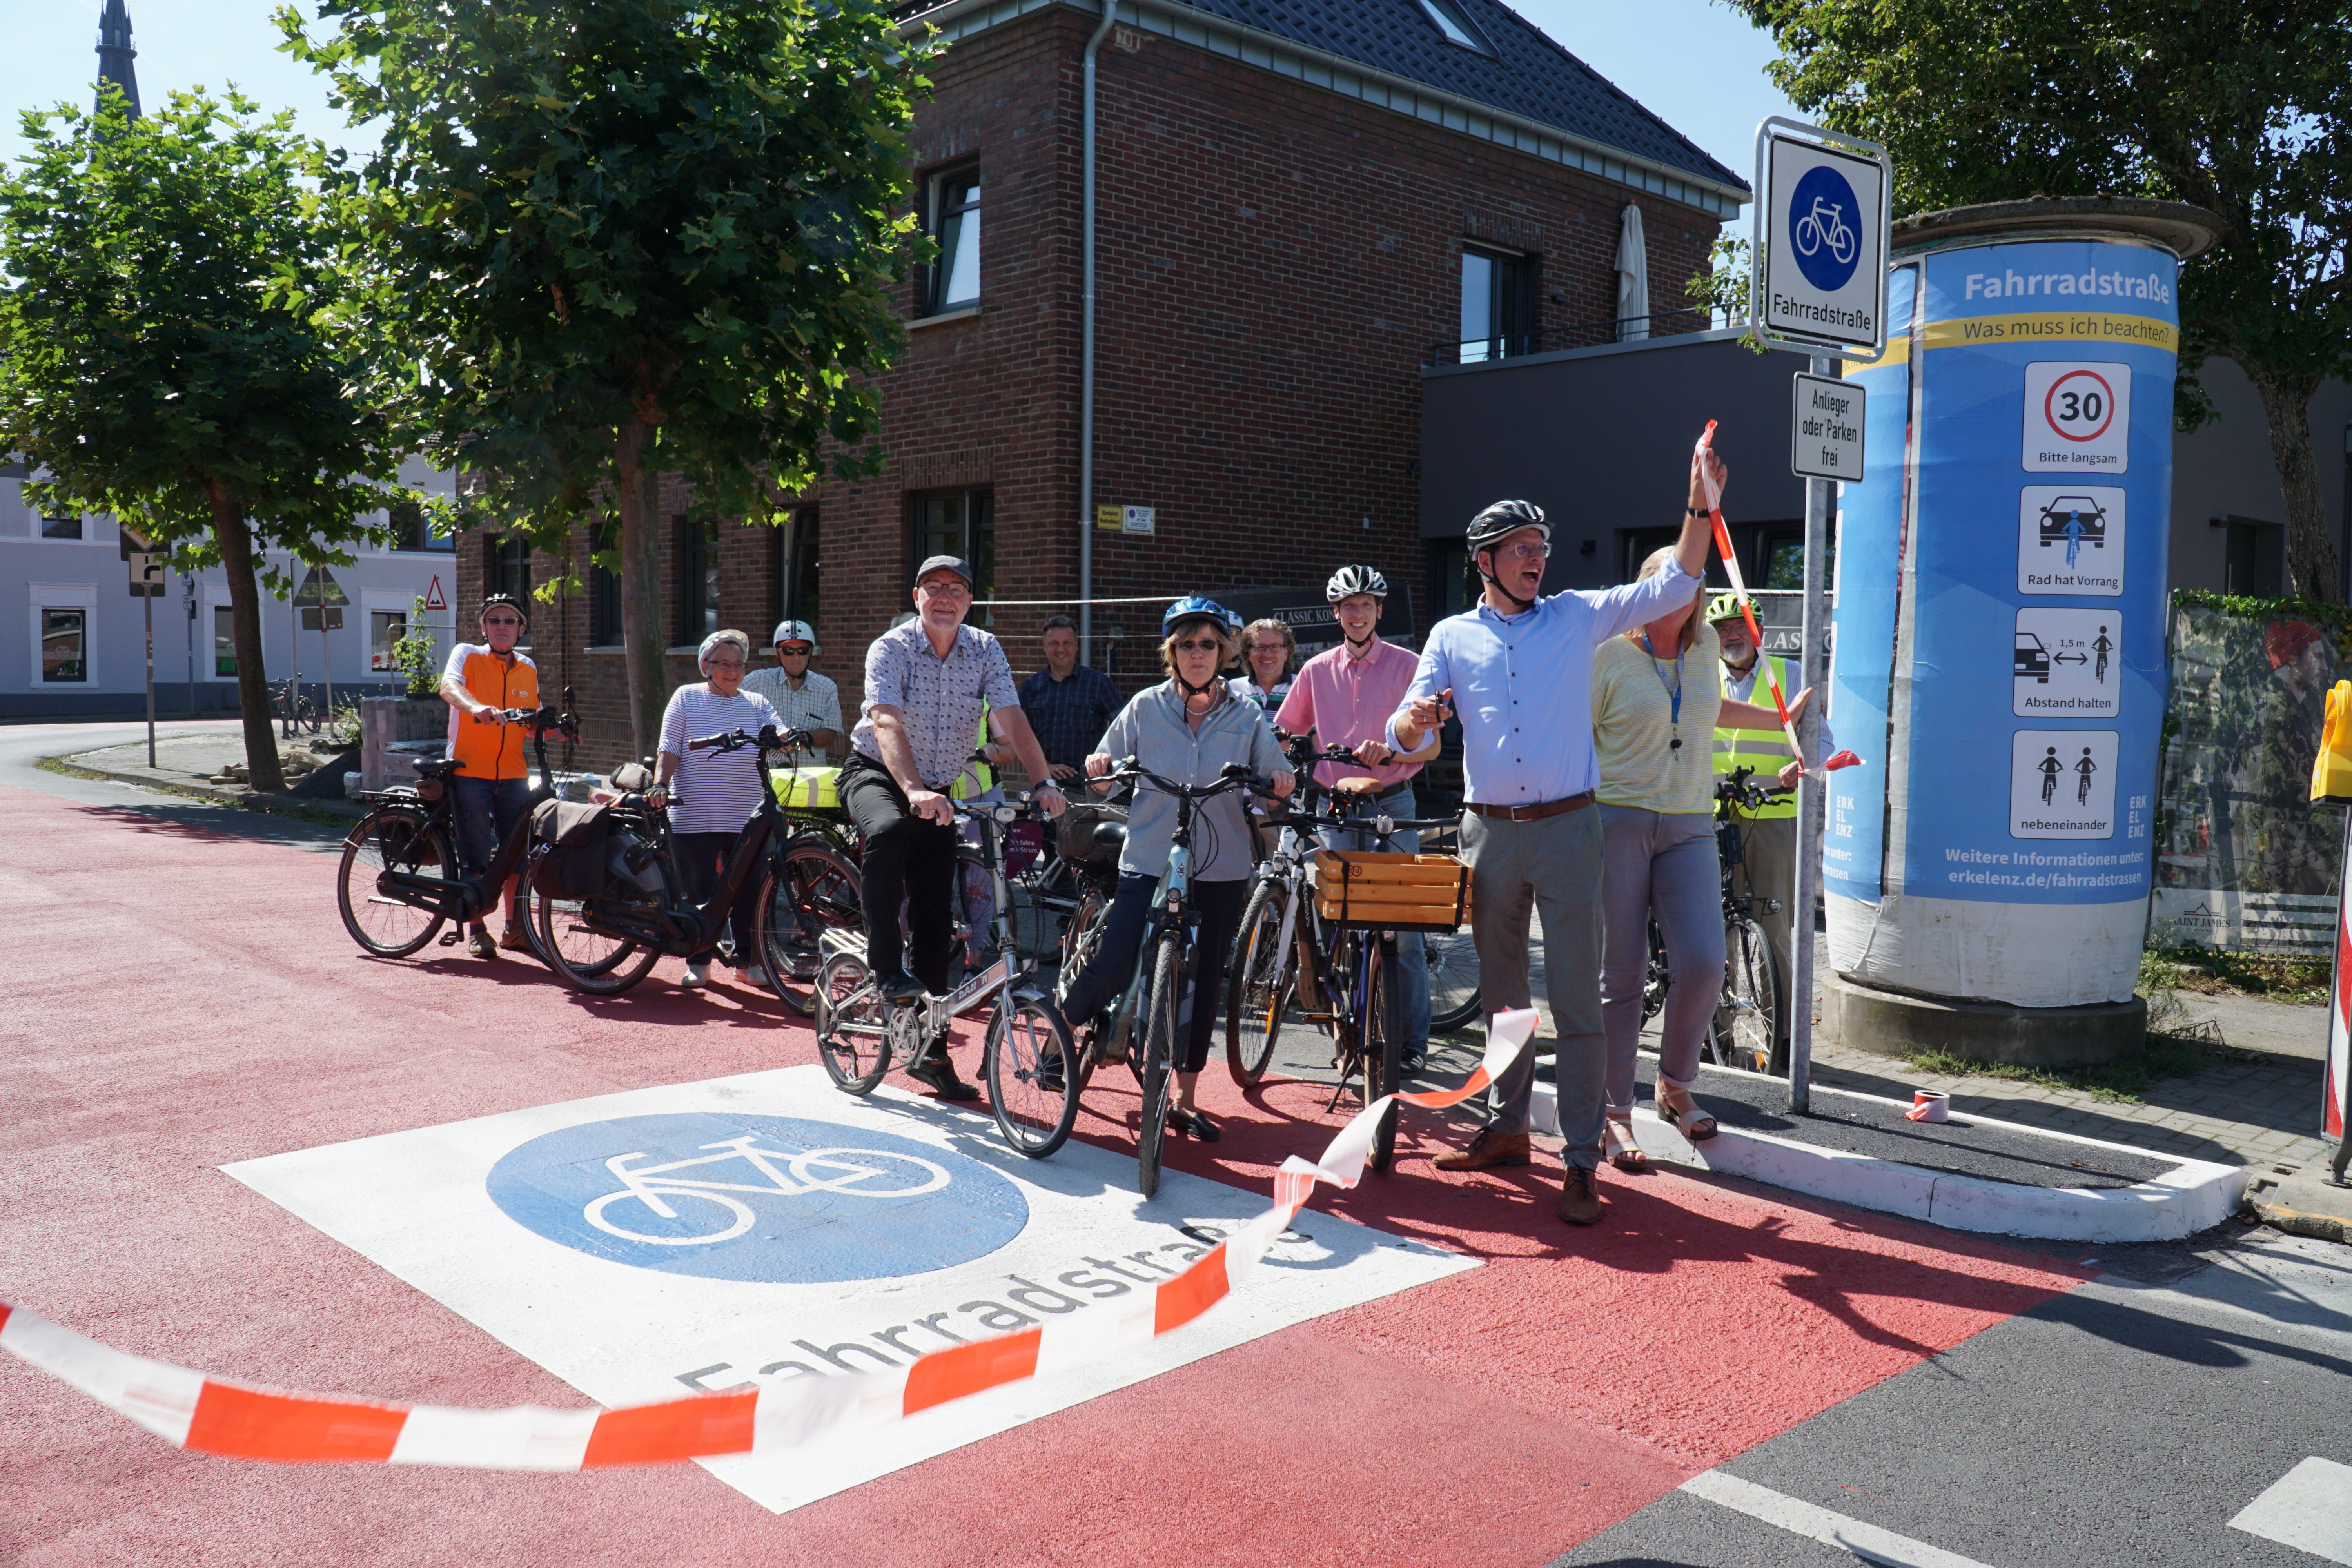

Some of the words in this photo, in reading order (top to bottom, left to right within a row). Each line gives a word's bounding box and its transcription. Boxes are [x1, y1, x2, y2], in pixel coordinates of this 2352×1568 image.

[1965, 267, 2169, 304] Fahrradstraße
[1774, 294, 1870, 330] Fahrradstraße
[1964, 321, 2004, 339] Was
[2011, 321, 2064, 336] muss
[2070, 317, 2097, 335] ich
[2104, 318, 2169, 343] beachten?
[1812, 389, 1849, 417] Anlieger
[2059, 392, 2102, 421] 30
[1803, 416, 1823, 437] oder
[1827, 419, 1857, 443] Parken
[1822, 446, 1837, 467] frei
[2040, 452, 2068, 462] Bitte
[2072, 452, 2117, 465] langsam
[2028, 575, 2051, 585] Rad
[2055, 575, 2074, 585] hat
[2077, 575, 2118, 589] Vorrang
[1274, 610, 1314, 624] CLASSIC
[1316, 609, 1335, 622] KON
[2060, 639, 2074, 648] 1,5
[2025, 697, 2074, 708] Abstand
[2078, 698, 2111, 708] halten
[1837, 796, 1854, 810] ERK
[2130, 795, 2147, 809] ERK
[1837, 809, 1846, 822] EL
[2129, 811, 2139, 824] EL
[1836, 823, 1853, 838] ENZ
[2021, 819, 2106, 830] nebeneinander
[2127, 824, 2145, 838] ENZ
[1831, 848, 1852, 861] unter:
[1945, 848, 2009, 864] Weitere
[2014, 851, 2117, 866] Informationen
[2120, 851, 2143, 864] unter:
[1949, 870, 2141, 889] erkelenz.de/fahrradstrassen
[1302, 880, 1310, 927] PEGASUS
[2172, 917, 2199, 926] SAINT
[2201, 918, 2230, 928] JAMES
